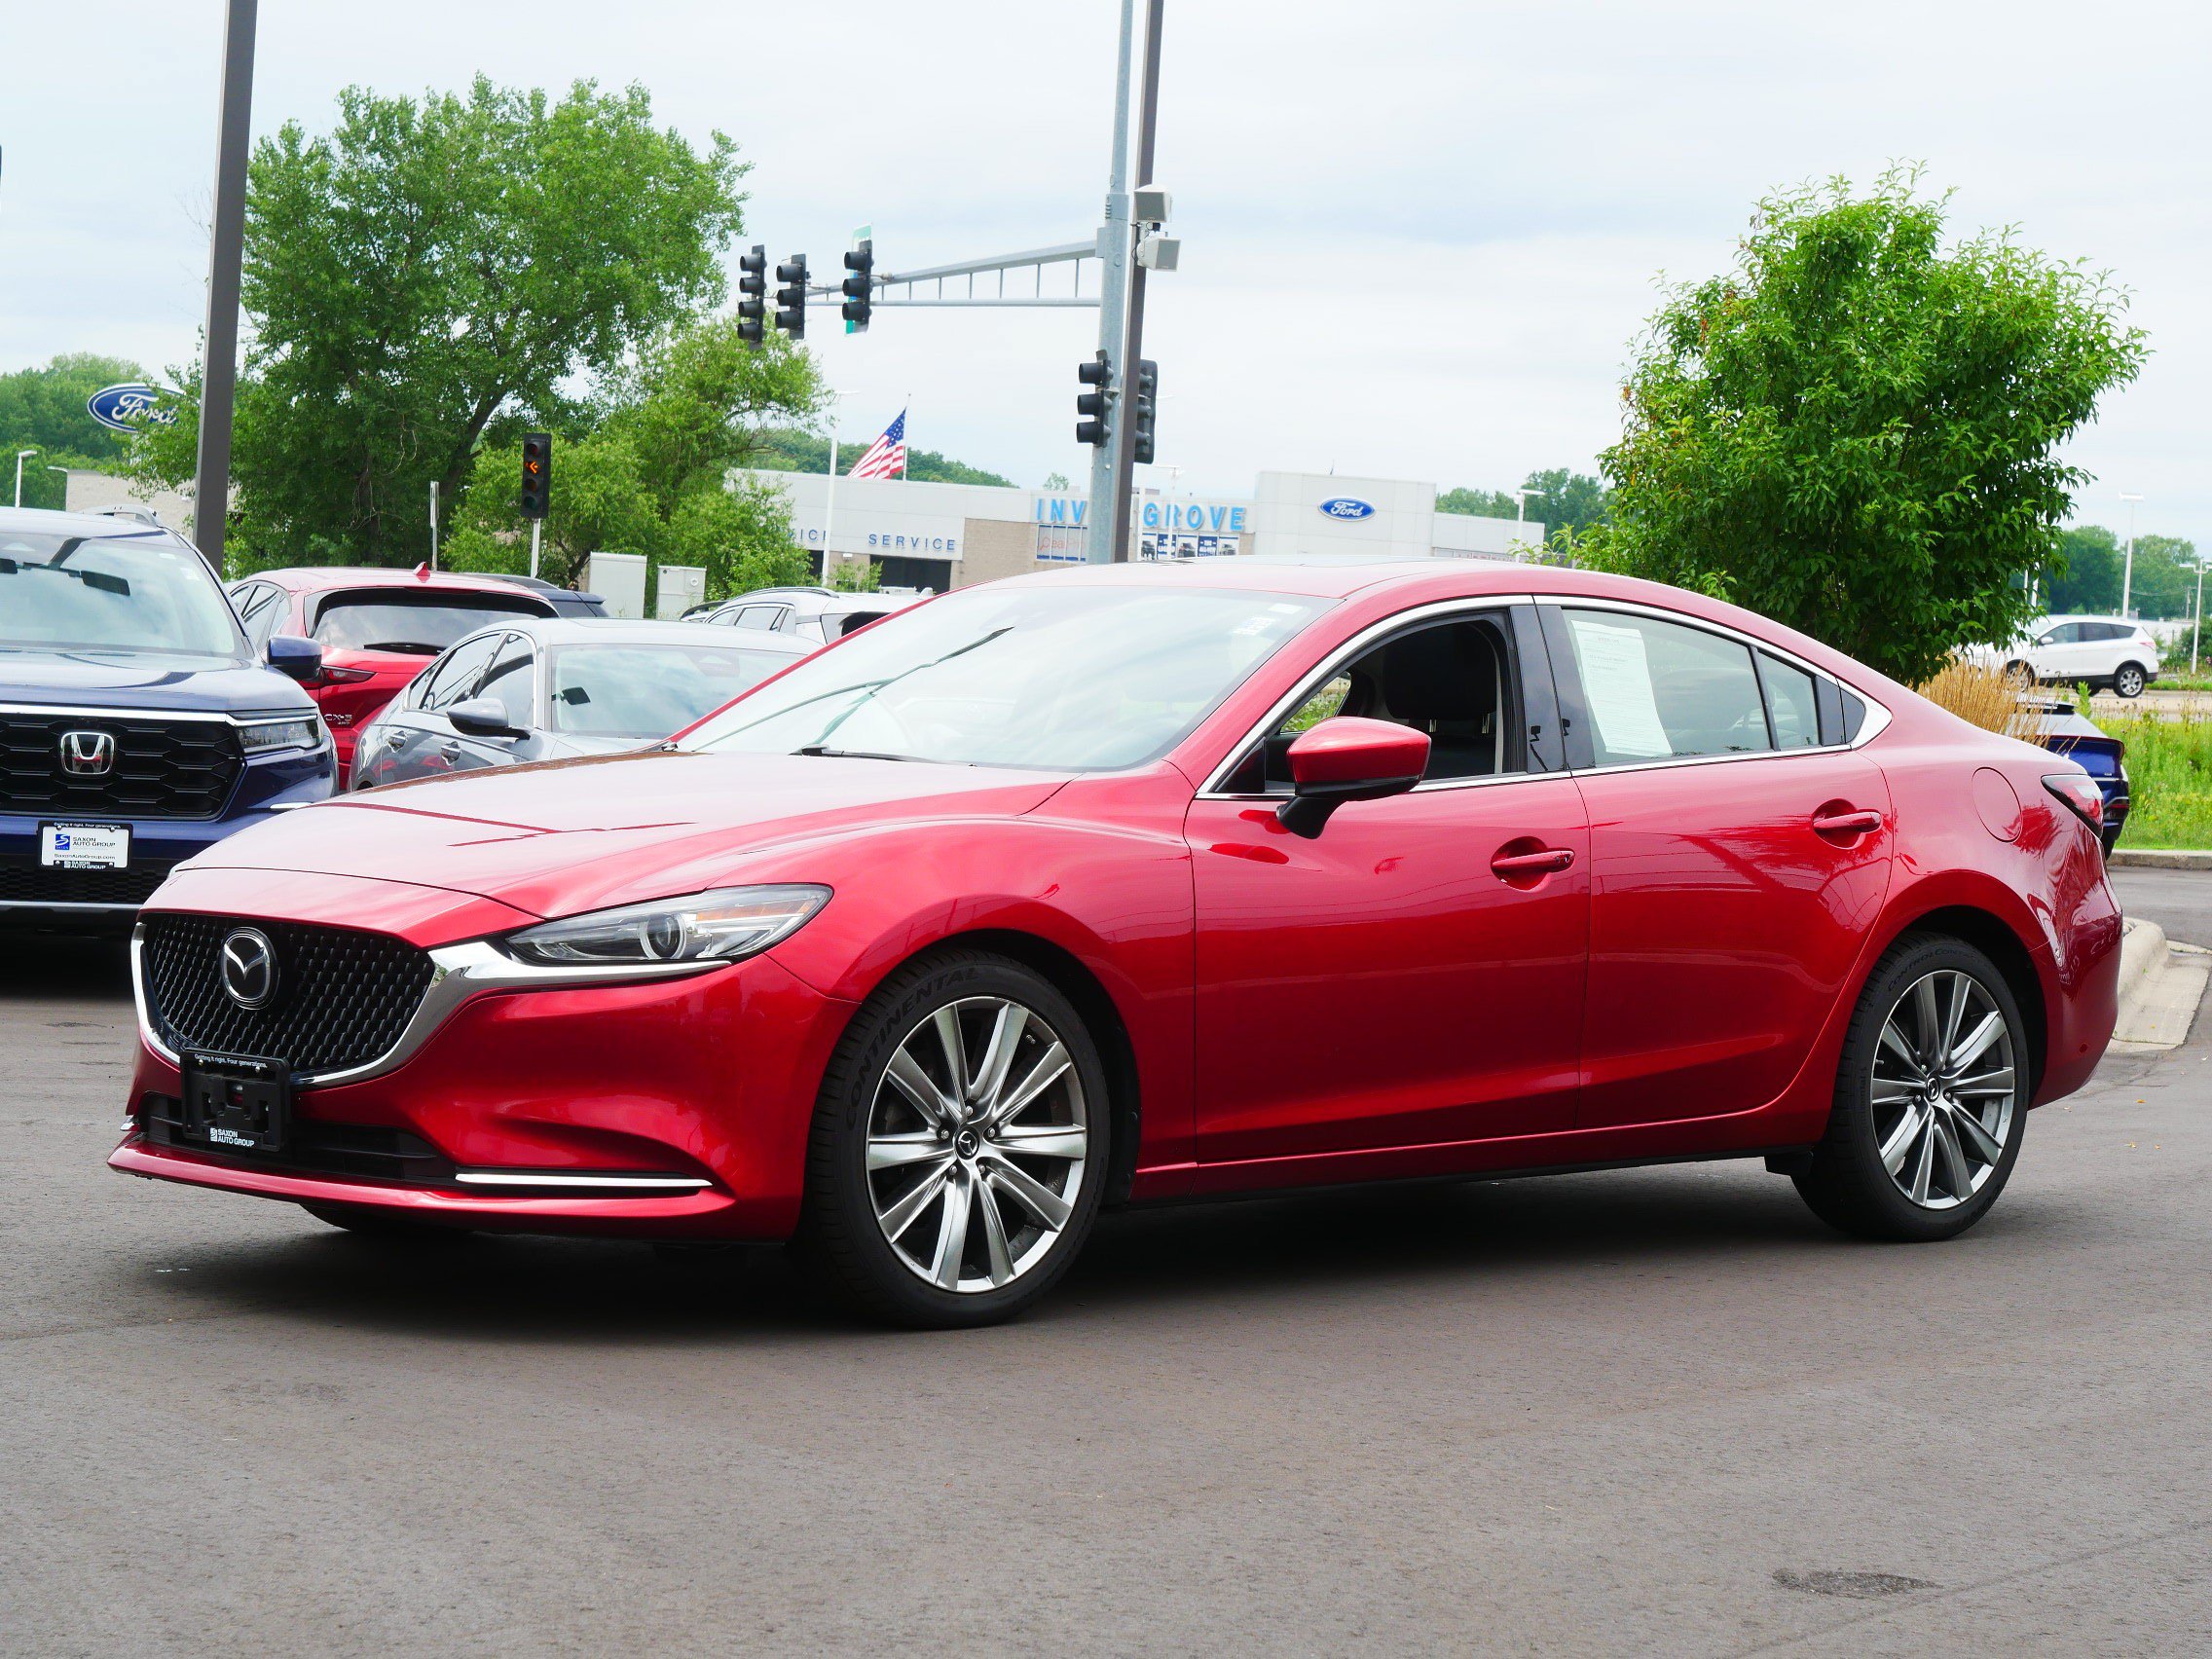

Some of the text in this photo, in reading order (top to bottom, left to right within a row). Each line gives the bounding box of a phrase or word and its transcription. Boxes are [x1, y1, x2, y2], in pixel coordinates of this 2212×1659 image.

[111, 393, 178, 424] Ford
[1037, 498, 1244, 531] INV GROVE
[1330, 500, 1364, 517] Ford
[868, 534, 956, 551] SERVICE
[847, 967, 981, 1129] CONTINENTAL
[217, 1128, 239, 1137] SAXON
[217, 1135, 255, 1148] AUTO GROUP
